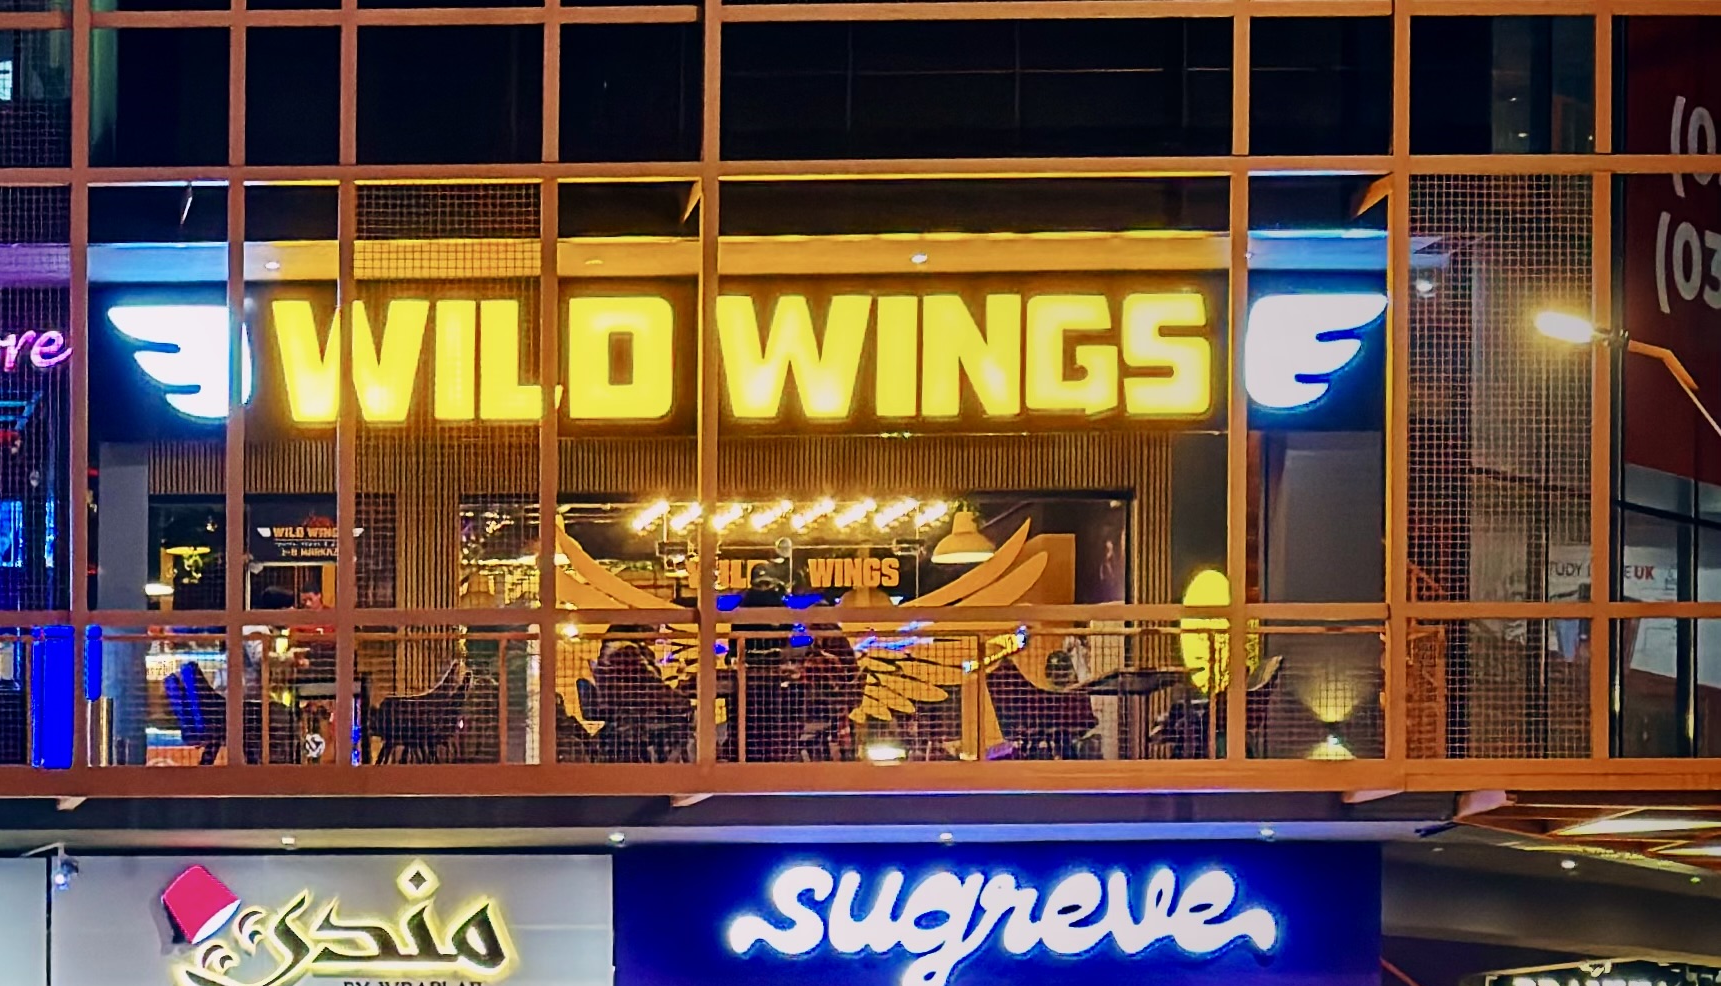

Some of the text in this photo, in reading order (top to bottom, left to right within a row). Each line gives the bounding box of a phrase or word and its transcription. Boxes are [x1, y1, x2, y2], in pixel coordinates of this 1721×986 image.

[272, 294, 1212, 422] WILD WINGS
[808, 557, 900, 588] WINGS
[1634, 565, 1655, 580] UK
